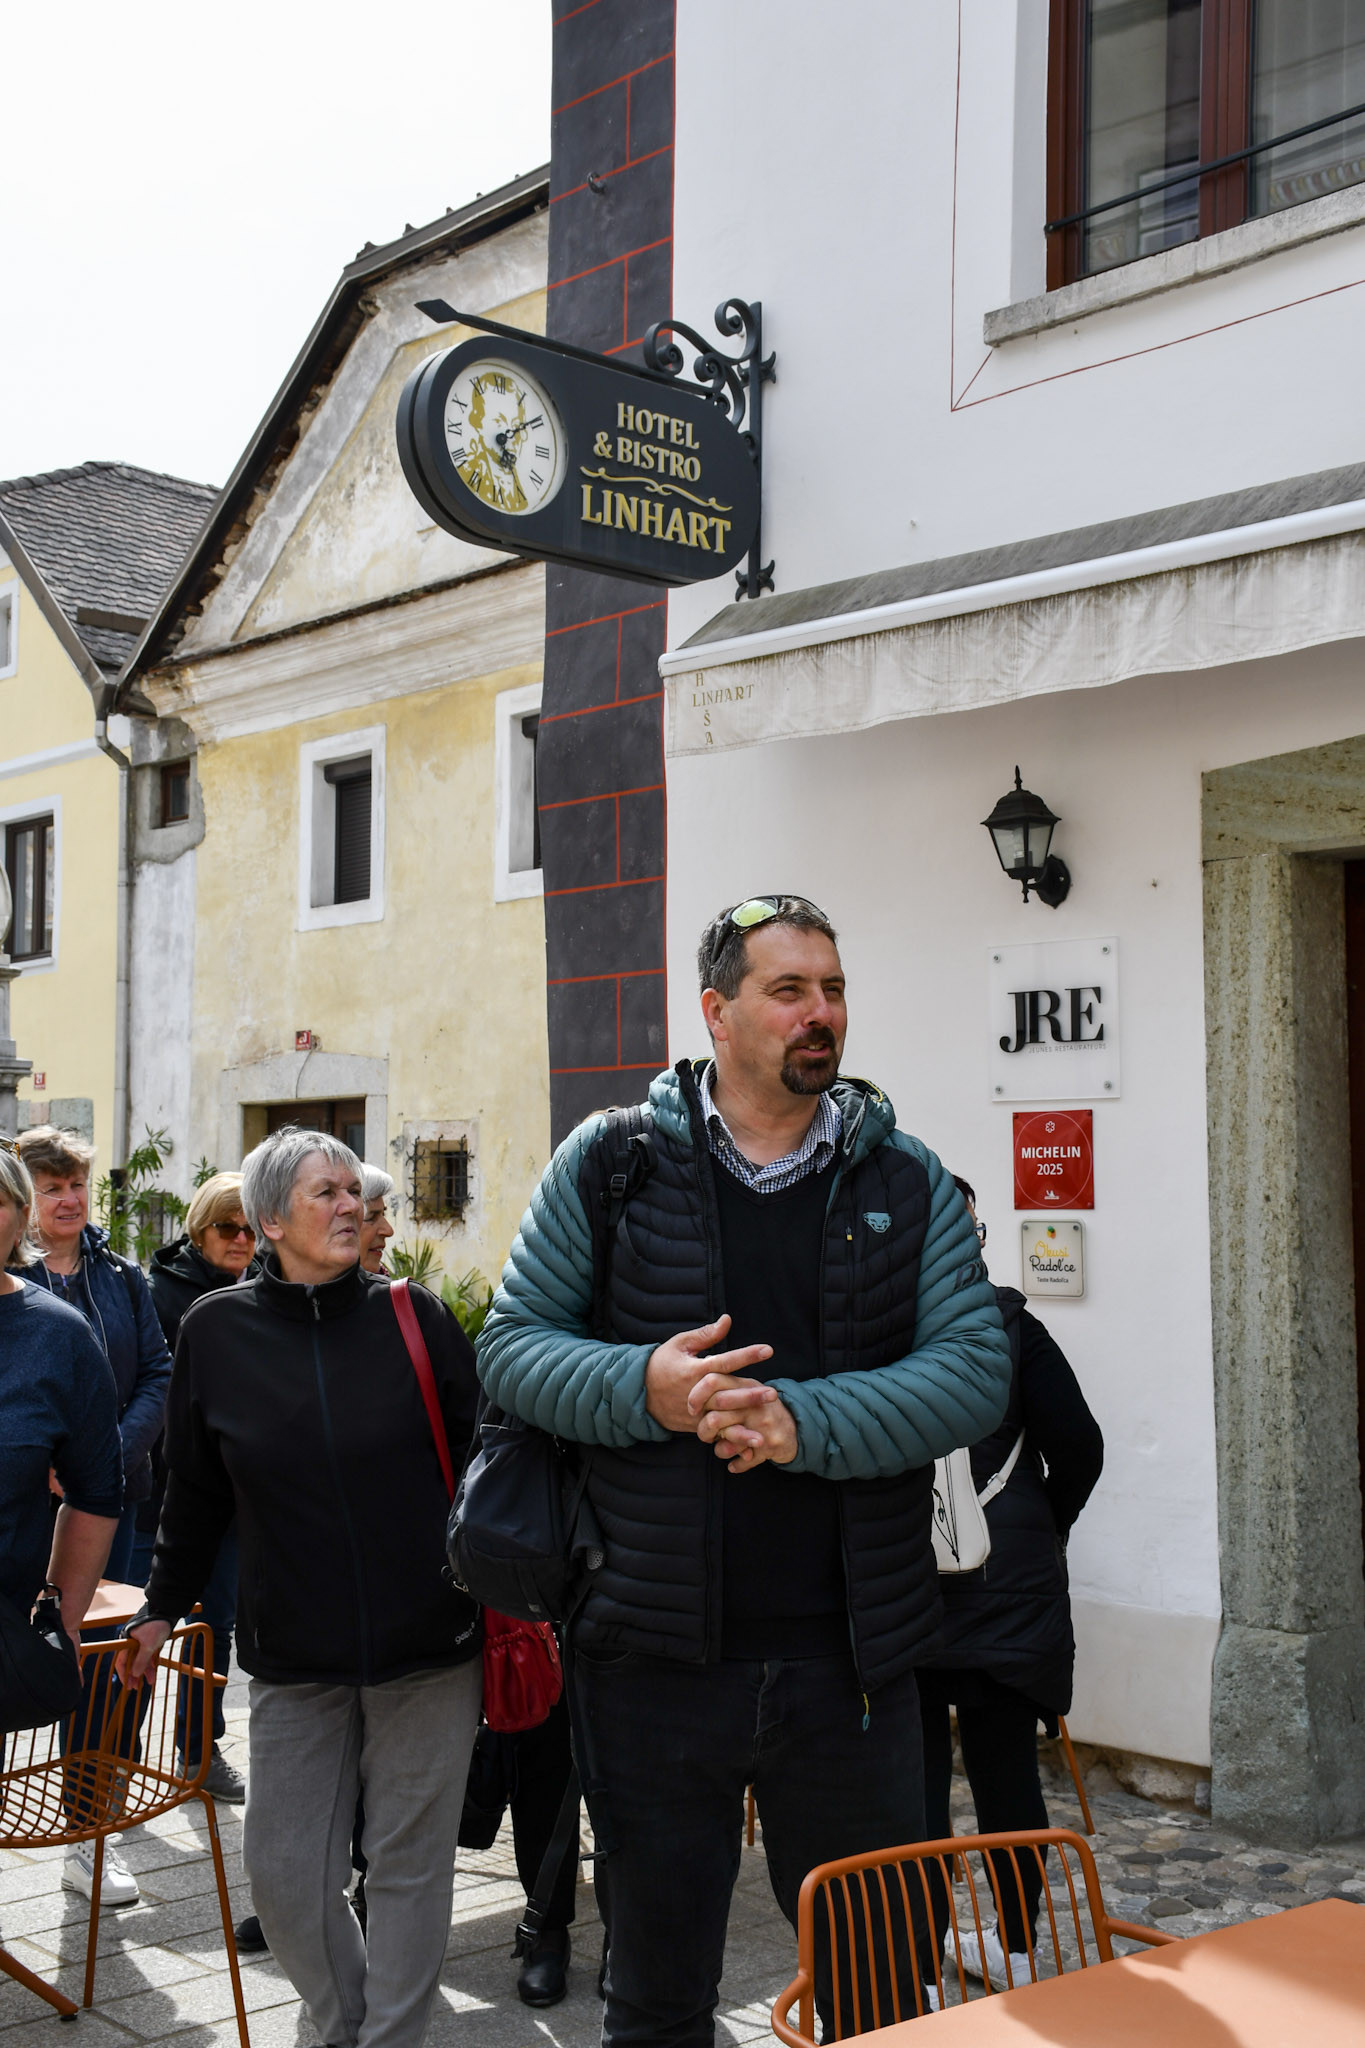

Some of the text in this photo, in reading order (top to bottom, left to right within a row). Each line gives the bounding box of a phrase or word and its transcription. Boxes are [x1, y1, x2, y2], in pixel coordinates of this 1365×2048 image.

[617, 402, 700, 449] HOTEL
[593, 431, 701, 482] & BISTRO
[581, 484, 732, 553] LINHART
[692, 684, 755, 707] LINHART
[999, 986, 1104, 1053] JRE
[1021, 1146, 1081, 1159] MICHELIN
[1037, 1163, 1063, 1175] 2025
